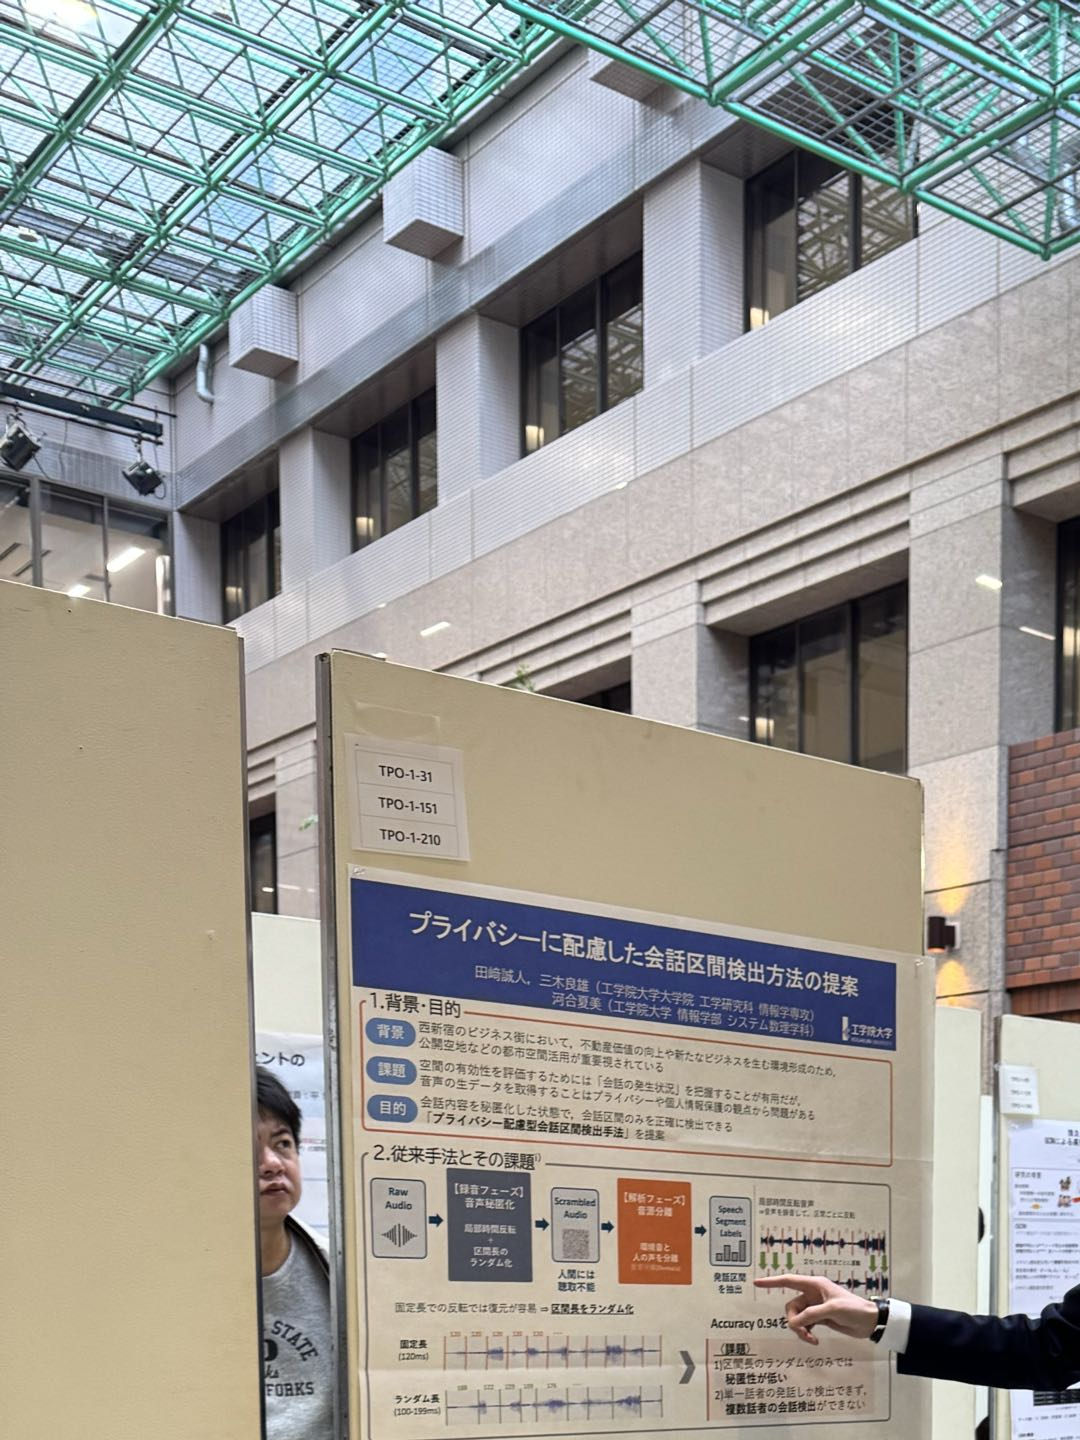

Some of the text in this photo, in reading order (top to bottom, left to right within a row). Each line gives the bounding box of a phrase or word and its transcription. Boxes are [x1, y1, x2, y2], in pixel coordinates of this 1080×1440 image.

[378, 765, 432, 782] TPO-1-31
[378, 796, 437, 814] TPO-1-151
[379, 828, 441, 845] TPO-1-210
[409, 910, 859, 997] プライバシーに配慮した会話区間検出方法の提案
[677, 1008, 722, 1025] 情報学部
[376, 1023, 404, 1039] 背景
[851, 1024, 893, 1039] 工学院大学
[256, 1052, 305, 1067] ントの
[377, 1062, 406, 1078] 課題
[380, 1101, 406, 1116] 目的
[388, 1187, 408, 1196] Raw
[385, 1201, 412, 1210] Audio
[554, 1197, 596, 1207] Scrambled
[563, 1211, 588, 1219] Audio
[718, 1205, 743, 1215] Speech
[716, 1217, 746, 1226] Segment
[720, 1230, 742, 1238] Labels
[558, 1269, 595, 1279] 人間には
[711, 1318, 755, 1330] Accuracy
[271, 1320, 319, 1361] STATE
[398, 1352, 429, 1362] (120ms)
[266, 1382, 314, 1397] FORKS
[394, 1394, 440, 1404] ランダム長
